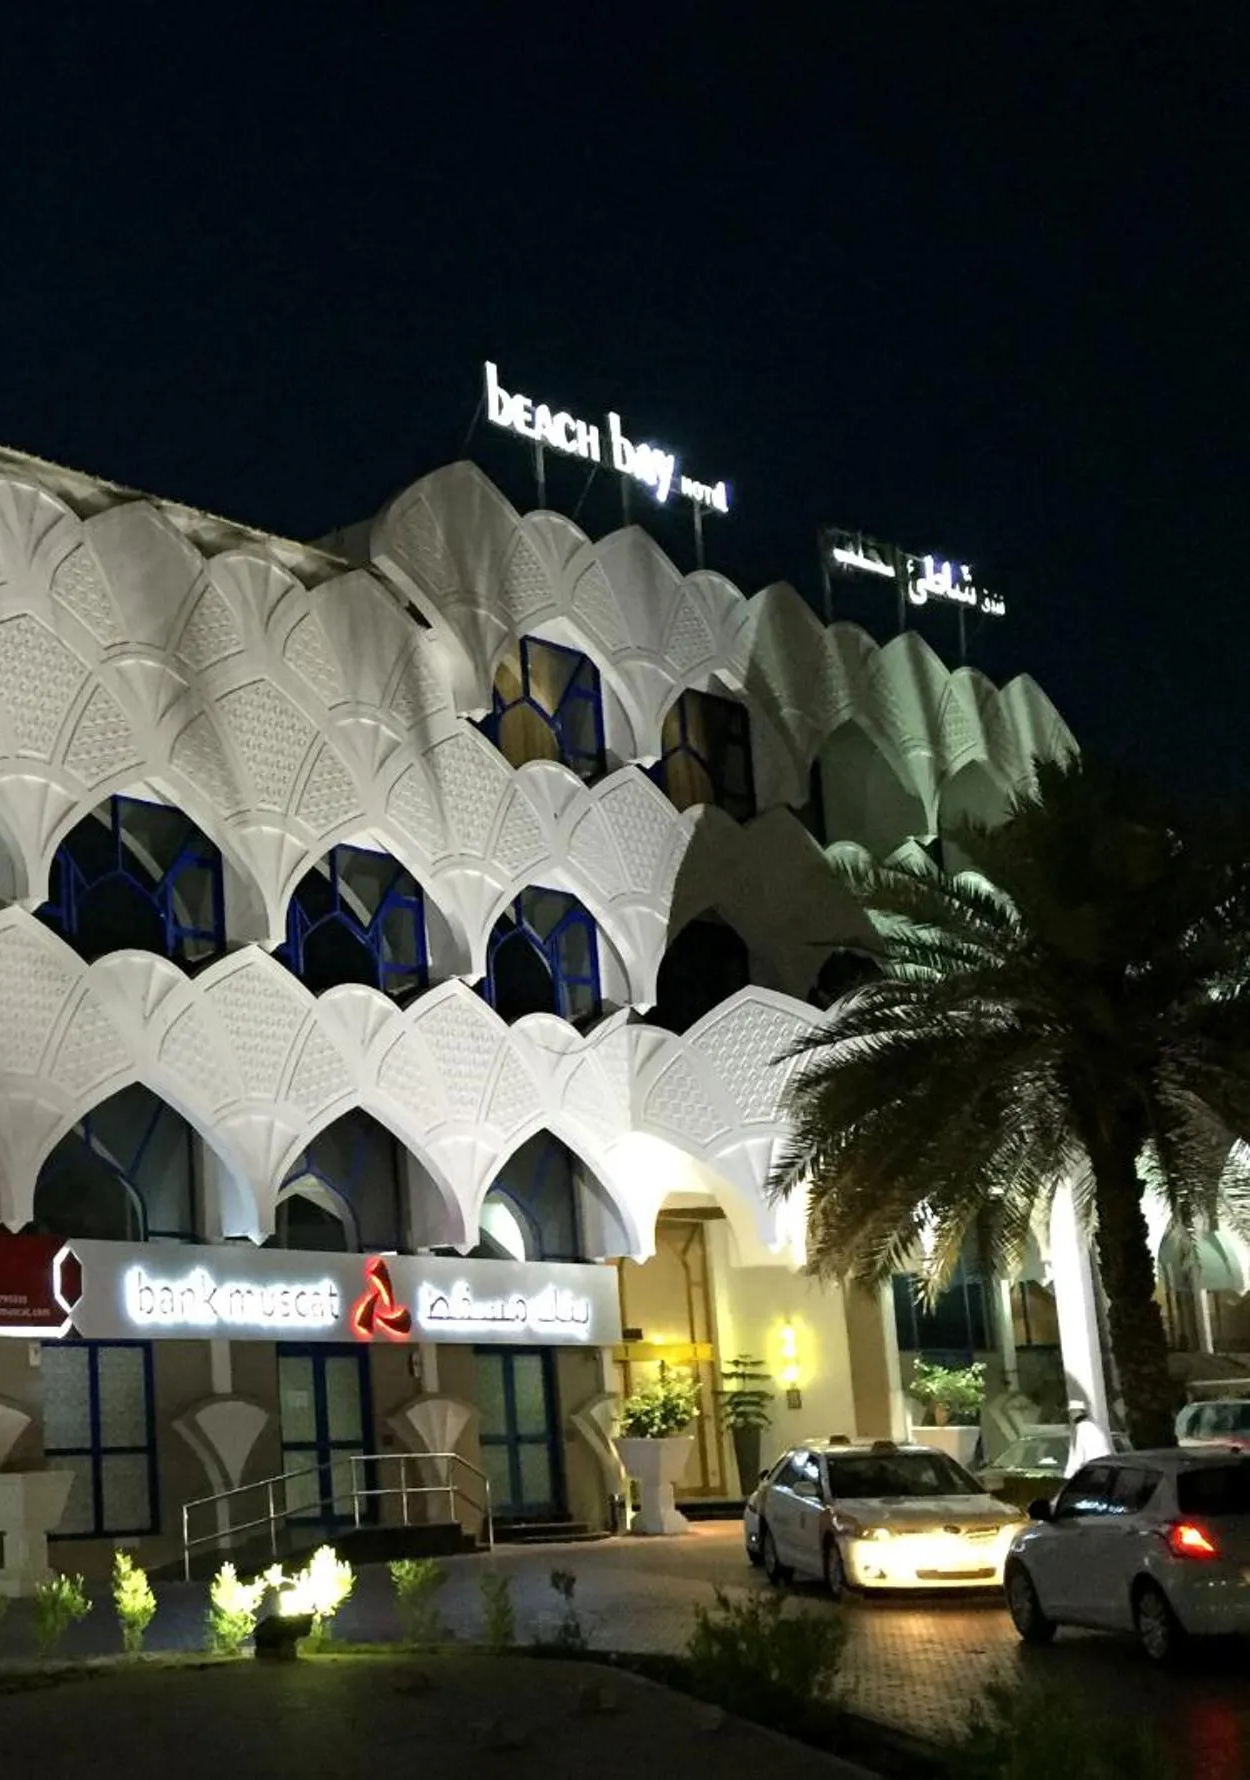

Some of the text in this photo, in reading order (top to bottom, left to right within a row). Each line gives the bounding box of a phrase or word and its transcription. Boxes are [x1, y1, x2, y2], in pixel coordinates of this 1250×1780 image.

[135, 1269, 341, 1321] bank muscat
[424, 1283, 529, 1323] مسقط
